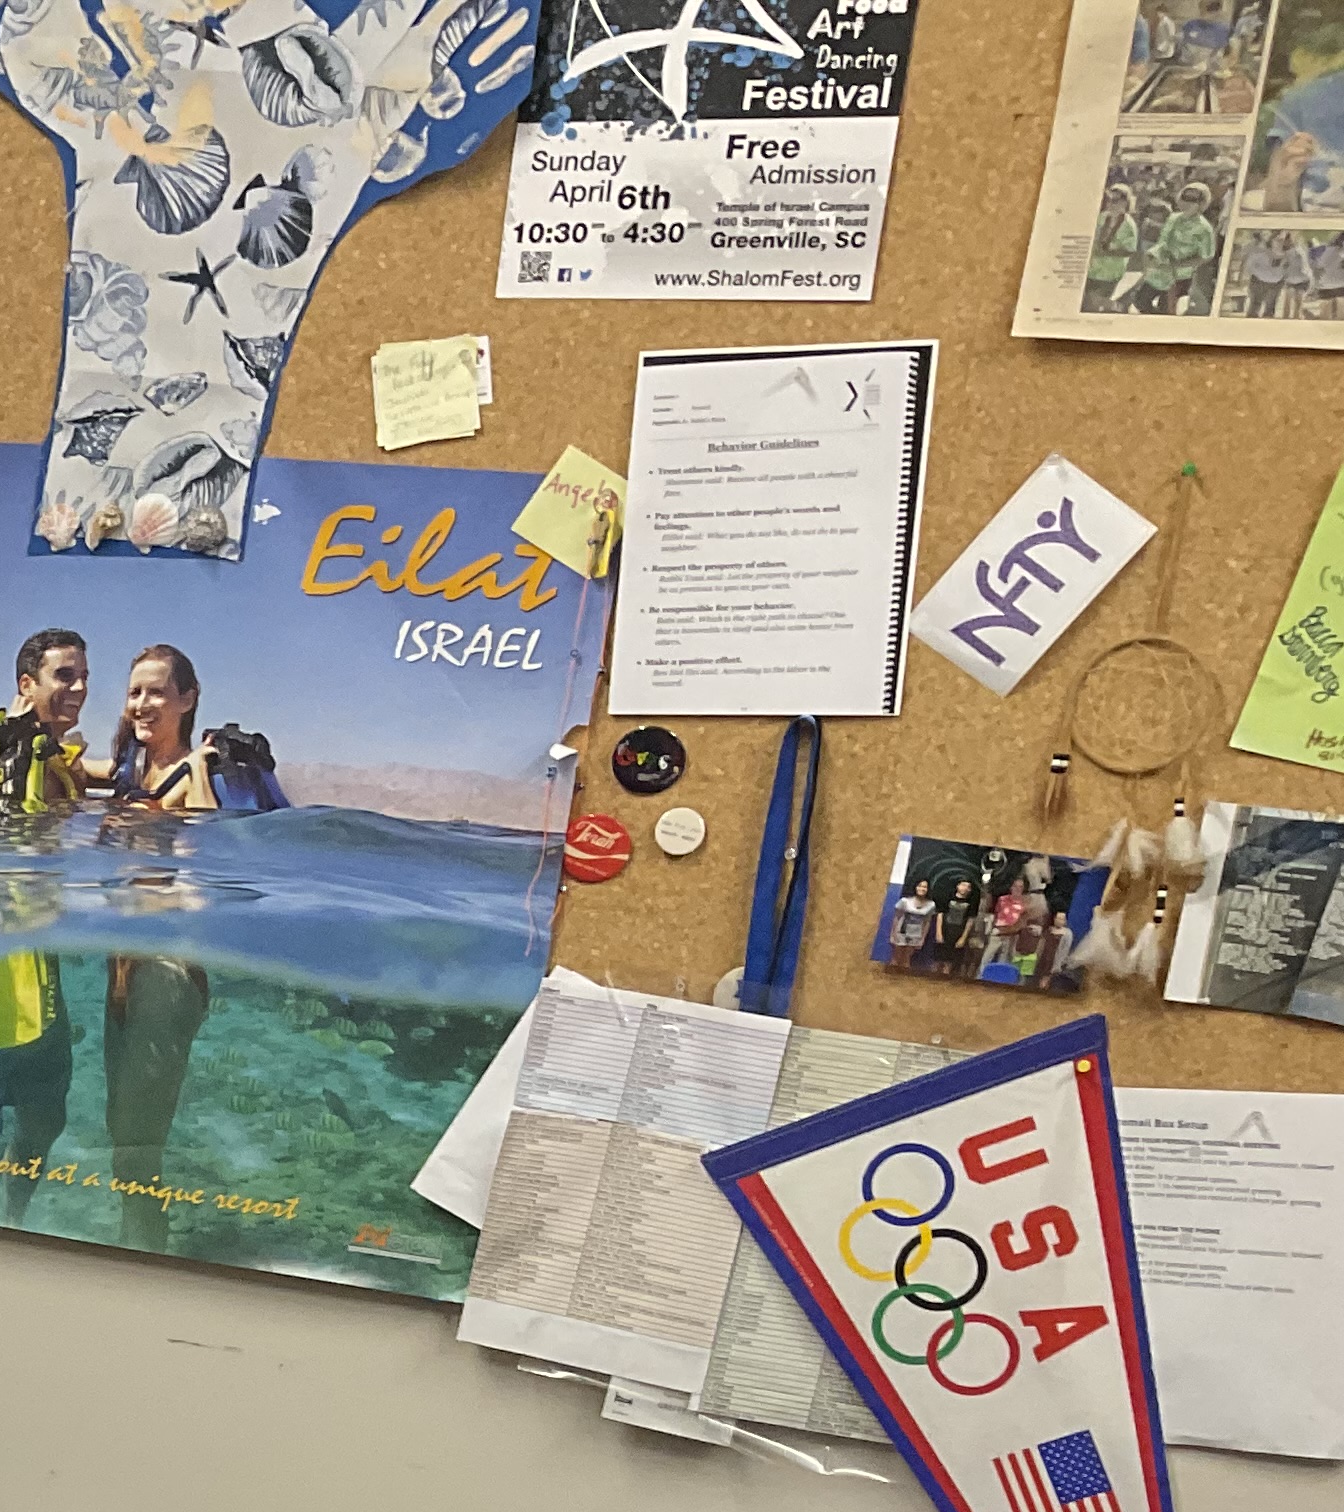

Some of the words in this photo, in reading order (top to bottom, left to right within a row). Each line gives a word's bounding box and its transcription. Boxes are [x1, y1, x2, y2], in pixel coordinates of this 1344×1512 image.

[807, 8, 865, 40] Art
[816, 44, 899, 77] Dancing
[742, 77, 893, 111] Festival
[726, 134, 801, 160] Free
[531, 150, 626, 175] Sunday
[749, 164, 876, 184] Admission
[549, 179, 611, 208] April
[617, 185, 671, 210] 6th
[716, 201, 760, 213] Temple
[764, 202, 776, 212] of
[780, 201, 814, 212] Israel
[818, 202, 870, 213] Campus
[513, 222, 588, 244] 10:30
[623, 221, 684, 243] 4:30
[714, 216, 737, 227] 400
[742, 216, 784, 229] Spring
[788, 216, 829, 228] Forest
[834, 216, 868, 227] Road
[711, 231, 827, 250] Greenville,
[834, 231, 867, 249] SC
[655, 269, 861, 291] www.ShalomFest.org
[707, 442, 757, 454] Behavior
[761, 438, 820, 451] Guidelines
[300, 504, 559, 612] Eilat
[949, 496, 1102, 667] NFTY
[394, 619, 543, 671] ISRAEL
[47, 1162, 79, 1187] at
[84, 1174, 100, 1187] a
[110, 1175, 205, 1212] unique
[212, 1193, 300, 1221] resort
[958, 1116, 1109, 1363] USA
